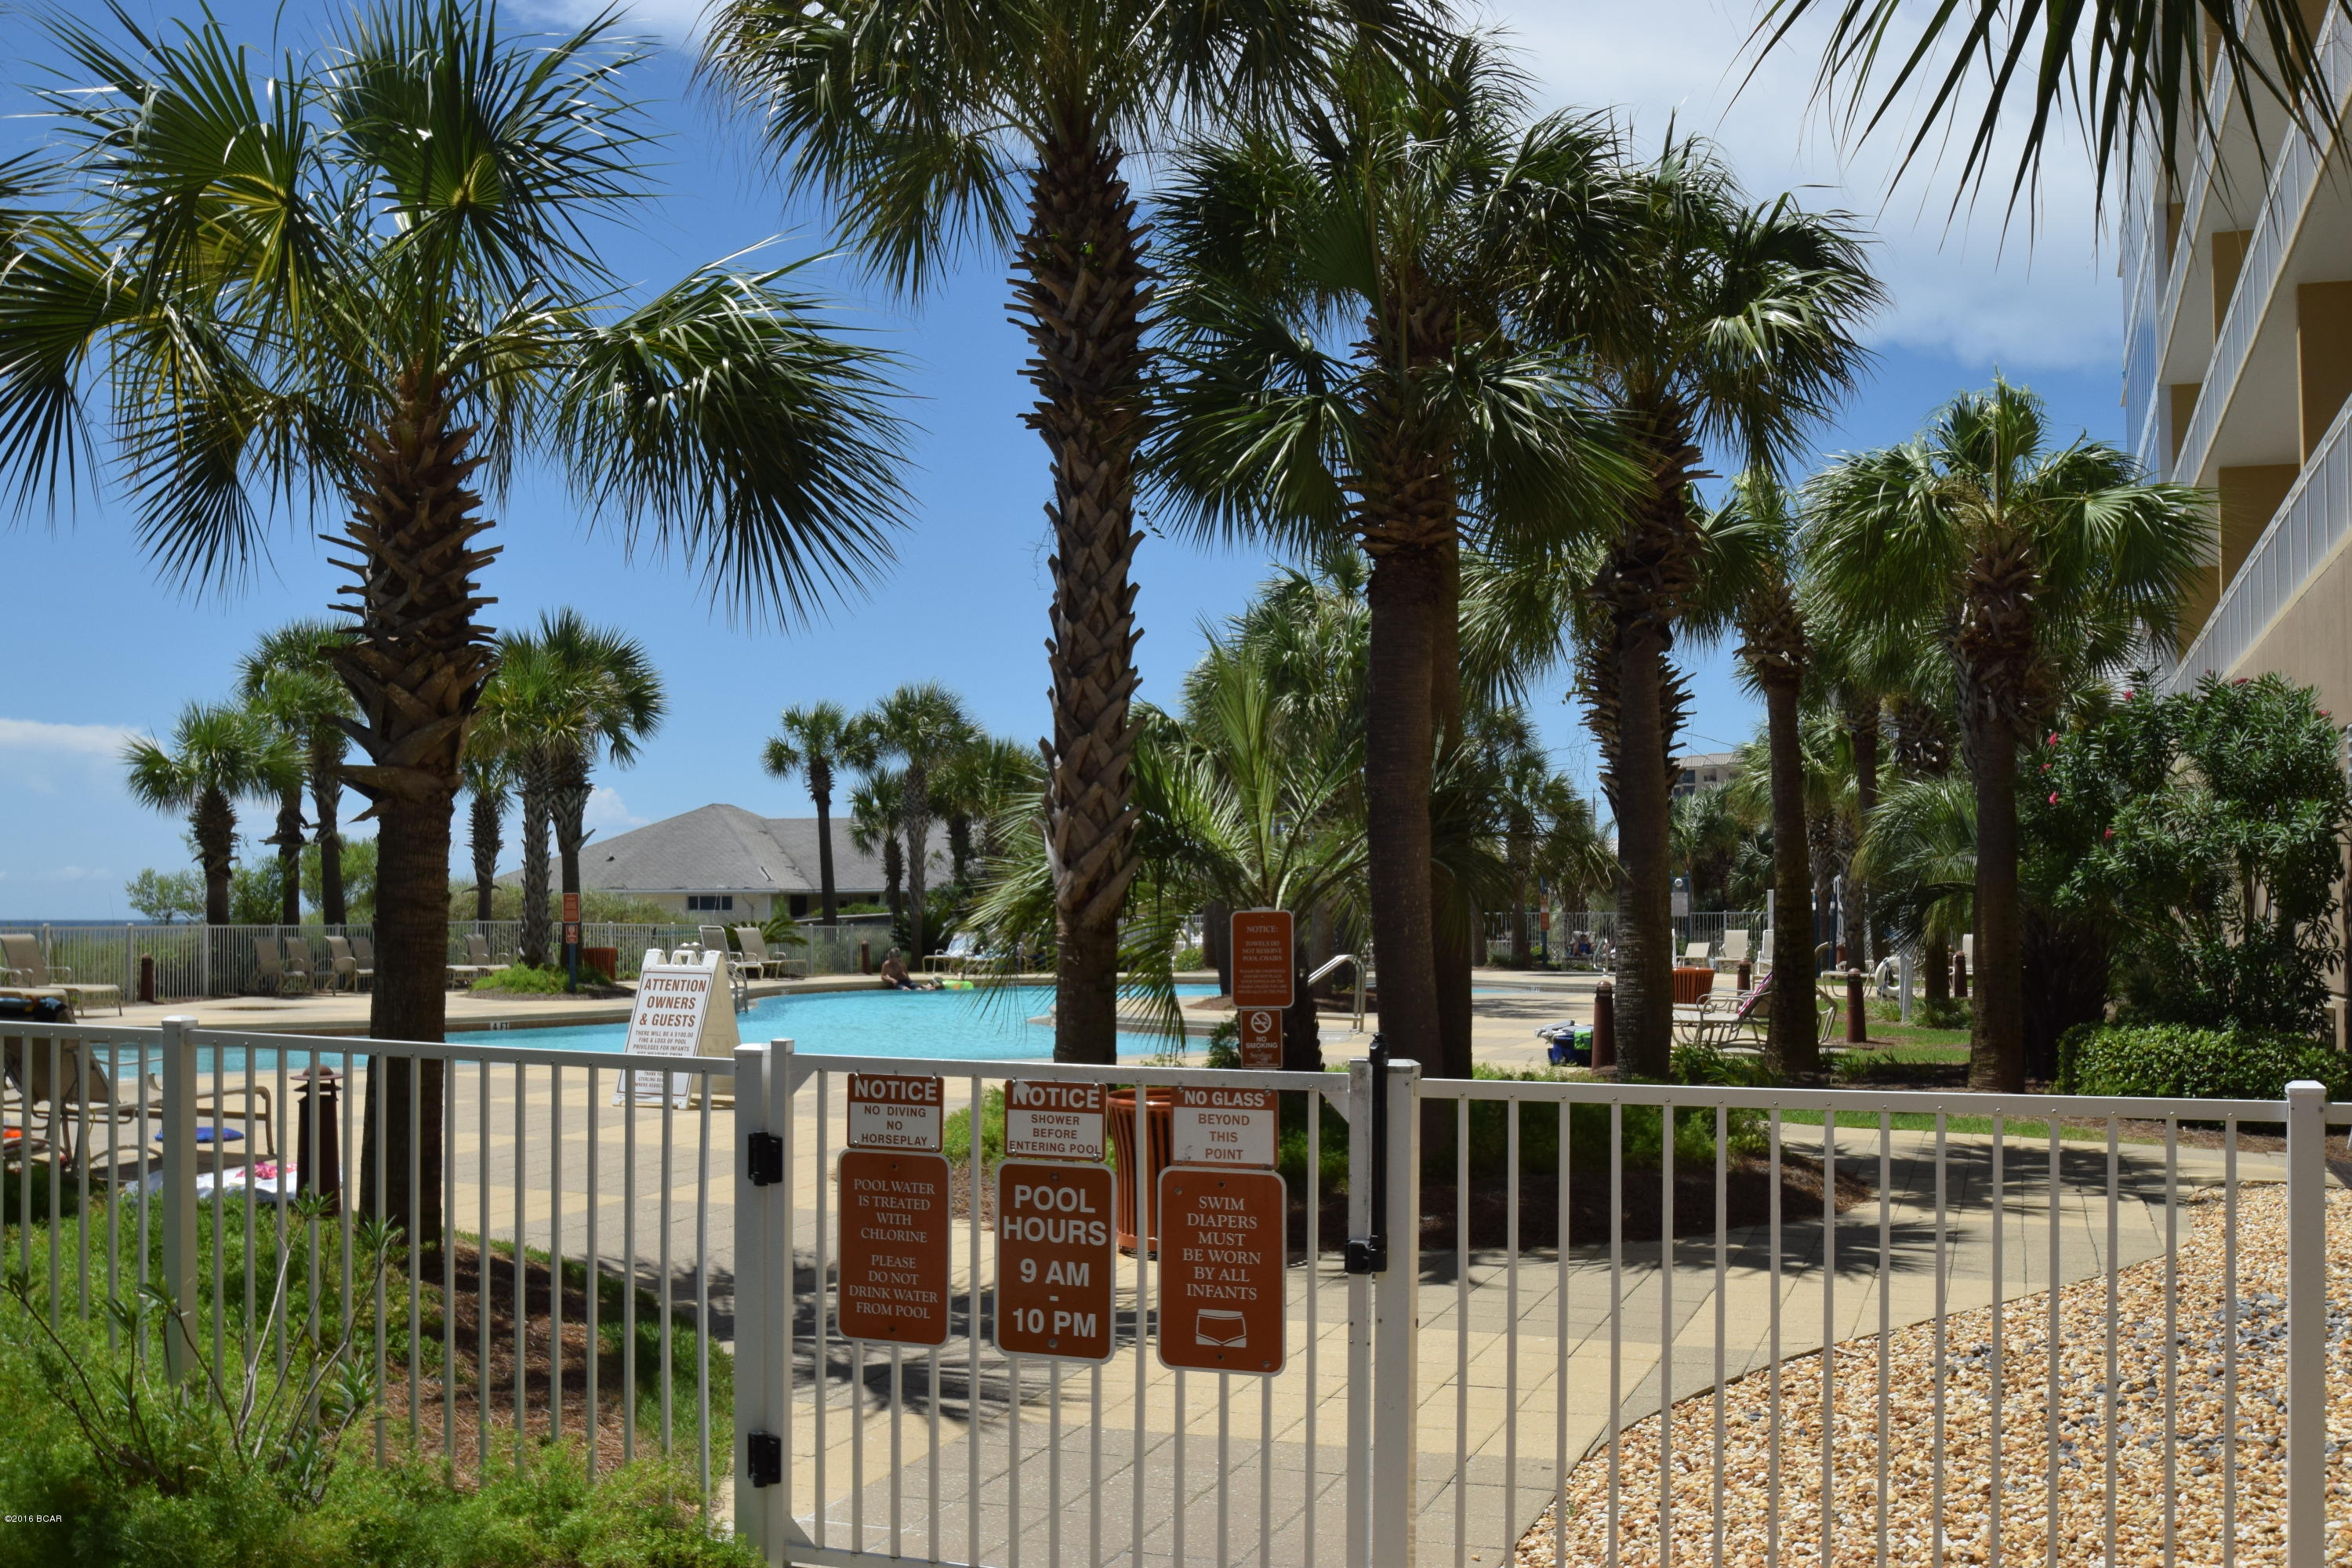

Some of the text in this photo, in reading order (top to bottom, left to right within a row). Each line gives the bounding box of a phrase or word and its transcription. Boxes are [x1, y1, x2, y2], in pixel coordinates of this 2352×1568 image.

[644, 978, 706, 992] ATTENTION
[647, 996, 696, 1009] OWNERS
[640, 1013, 695, 1027] & GUESTS
[855, 1079, 938, 1101] NOTICE
[1013, 1087, 1100, 1109] NOTICE
[1185, 1091, 1265, 1107] NO GLASS
[865, 1105, 926, 1117] NO DIVING
[887, 1121, 902, 1131] NO
[1031, 1114, 1080, 1125] SHOWER
[1198, 1114, 1250, 1126] BEYOND
[862, 1134, 927, 1146] HORSEPLAY
[1033, 1128, 1077, 1139] BEFORE
[1209, 1131, 1238, 1142] THIS
[1010, 1141, 1101, 1154] ENTERING POOL
[1205, 1149, 1243, 1160] POINT
[854, 1179, 935, 1194] POOL WATER
[858, 1196, 930, 1210] IS TREATED
[1014, 1185, 1096, 1213] POOL
[1199, 1196, 1245, 1210] SWIM
[877, 1213, 912, 1225] WITH
[1187, 1214, 1258, 1229] DIAPERS
[861, 1228, 927, 1243] CHLORINE
[1004, 1215, 1107, 1246] HOURS
[1198, 1232, 1246, 1247] MUST
[872, 1254, 916, 1269] PLEASE
[1183, 1248, 1261, 1264] BE WORN
[869, 1271, 919, 1285] DO NOT
[1020, 1258, 1089, 1287] 9 AM
[1194, 1267, 1250, 1282] BY ALL
[849, 1286, 938, 1303] DRINK WATER
[1186, 1283, 1257, 1300] INFANTS
[856, 1301, 931, 1319] FROM POOL
[1013, 1308, 1096, 1338] 10 PM
